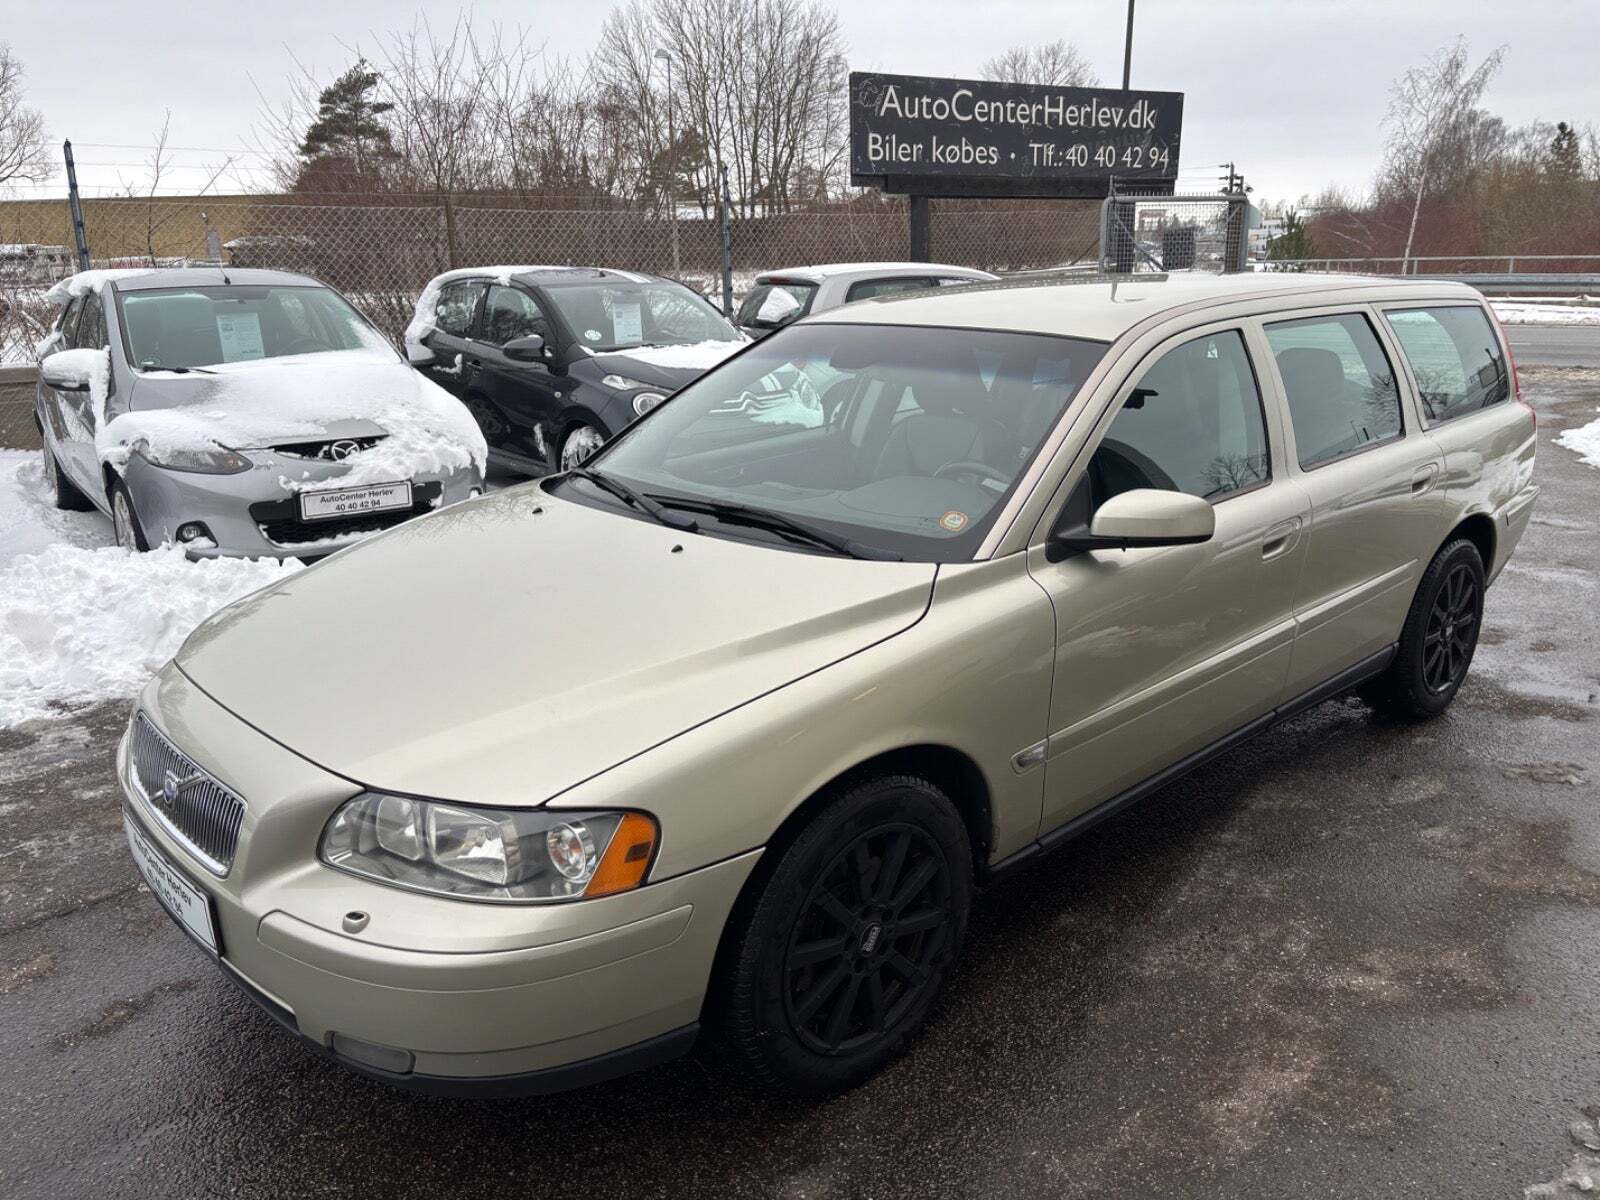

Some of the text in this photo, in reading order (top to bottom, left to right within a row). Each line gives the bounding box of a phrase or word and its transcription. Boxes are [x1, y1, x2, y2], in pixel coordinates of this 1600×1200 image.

[880, 85, 1156, 129] AutoCenterHerlev.dk
[868, 132, 923, 162] Biler
[932, 135, 998, 165] købes
[1094, 146, 1116, 168] 40
[1121, 147, 1143, 169] 42
[1149, 147, 1169, 175] 94
[320, 488, 394, 504] AutoCenter Herlev
[335, 504, 346, 512] 40
[347, 502, 358, 510] 40
[360, 500, 370, 508] 42
